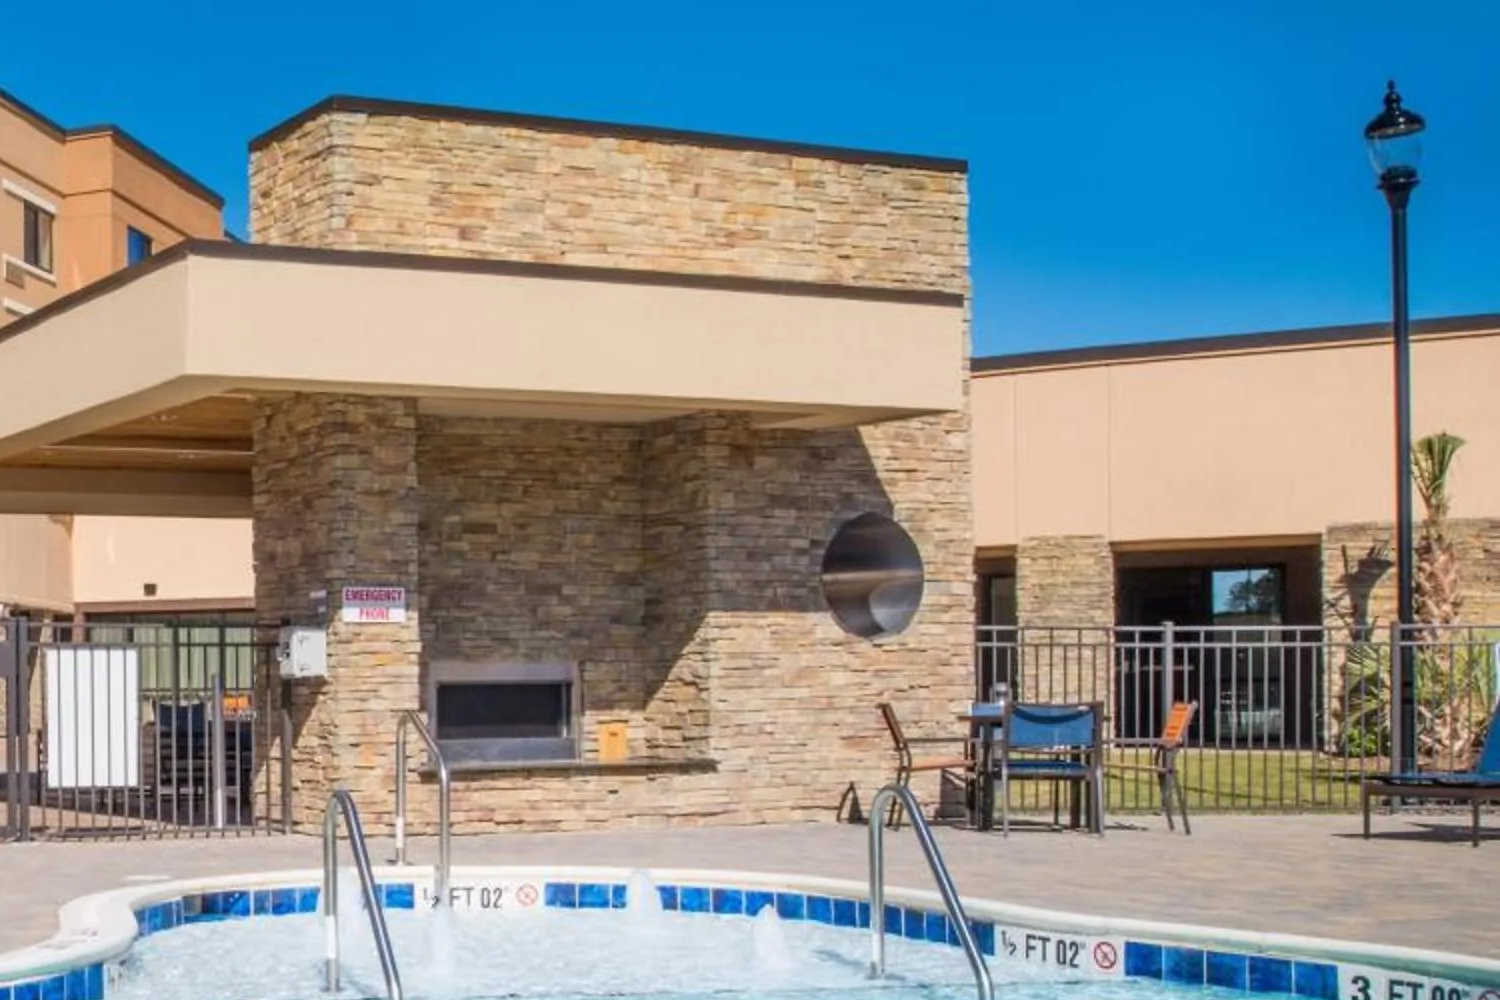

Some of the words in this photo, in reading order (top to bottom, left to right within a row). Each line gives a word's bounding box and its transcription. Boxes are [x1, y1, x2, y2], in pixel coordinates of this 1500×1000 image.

[345, 588, 402, 602] EMERGENCY
[359, 607, 390, 620] PHONE
[449, 886, 476, 908] FT
[1025, 933, 1052, 962] FT
